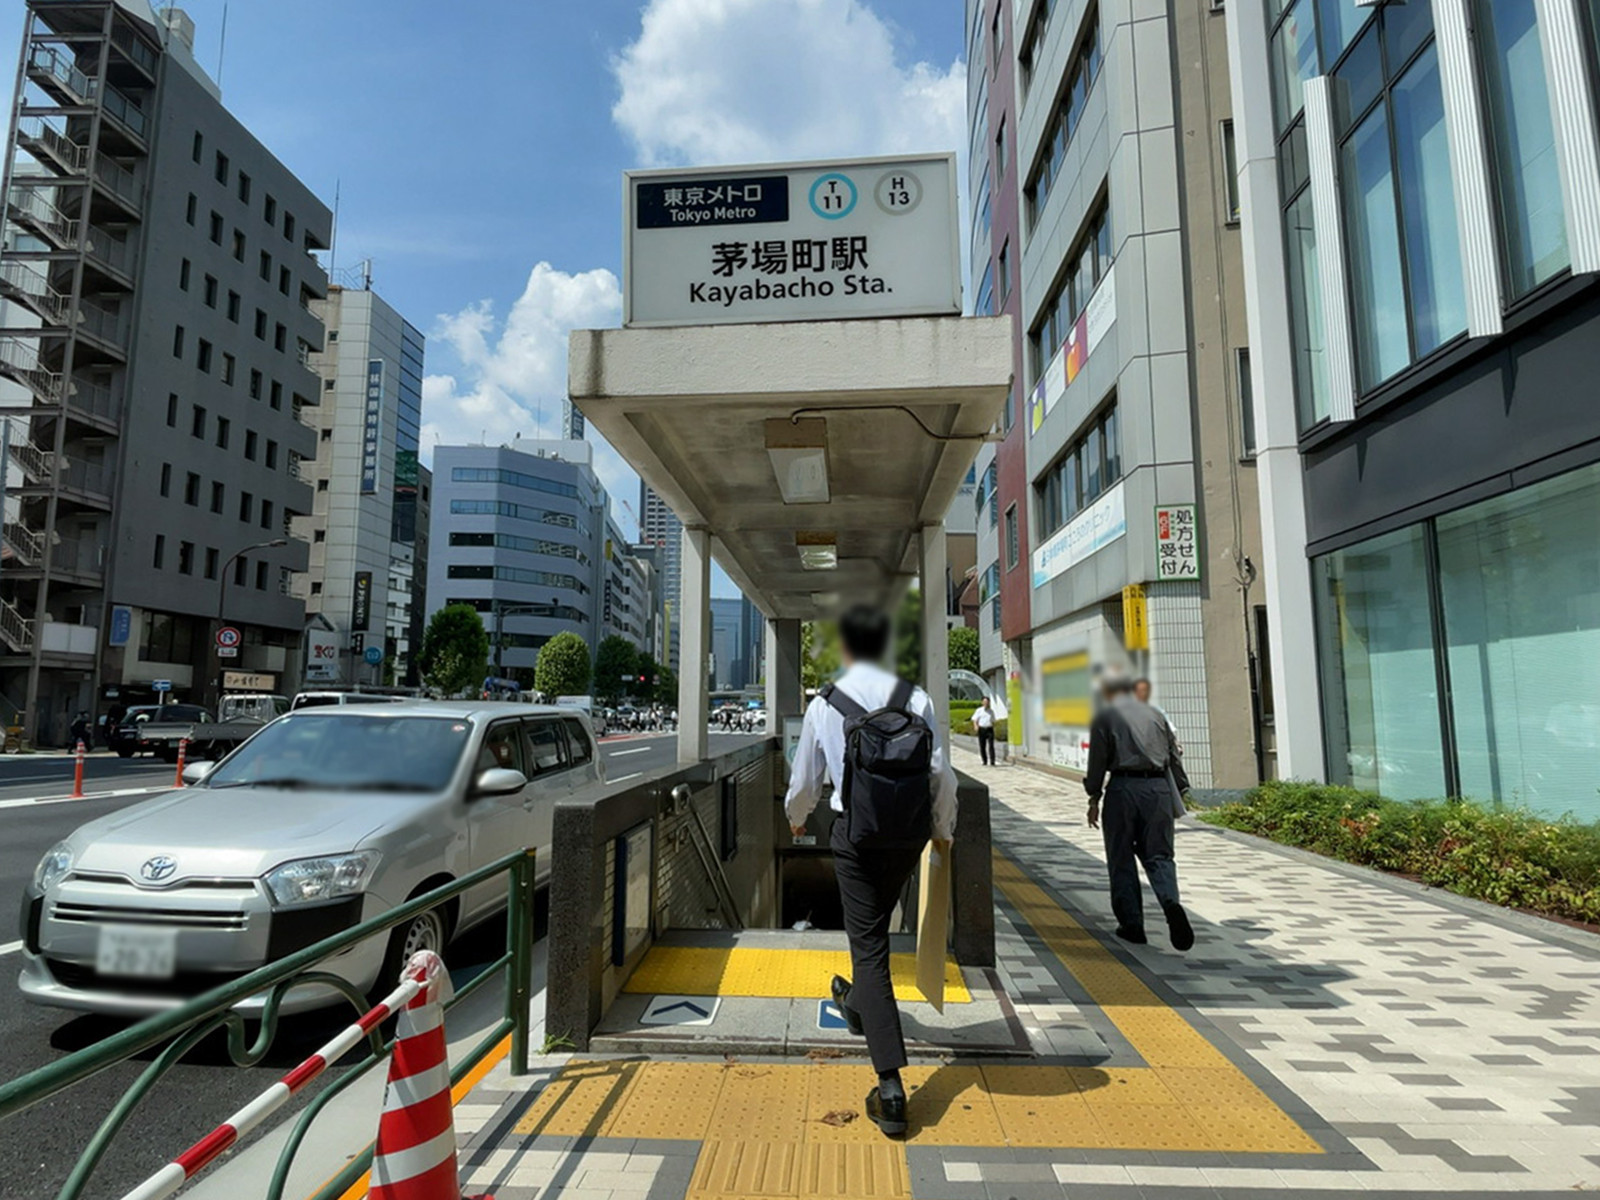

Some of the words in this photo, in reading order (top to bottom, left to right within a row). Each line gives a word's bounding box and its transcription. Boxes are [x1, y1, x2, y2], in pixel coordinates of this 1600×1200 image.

[828, 181, 838, 194] T
[892, 177, 904, 190] H
[663, 184, 762, 206] 東京メトロ
[823, 195, 843, 209] 11
[888, 191, 910, 206] 13
[670, 209, 711, 224] Tokyo
[714, 206, 757, 221] Metro
[711, 236, 869, 277] 茅場町駅
[690, 276, 834, 307] Kayabacho
[844, 275, 893, 296] Sta.
[1176, 509, 1196, 575] 処方せん
[1160, 542, 1177, 575] 受付
